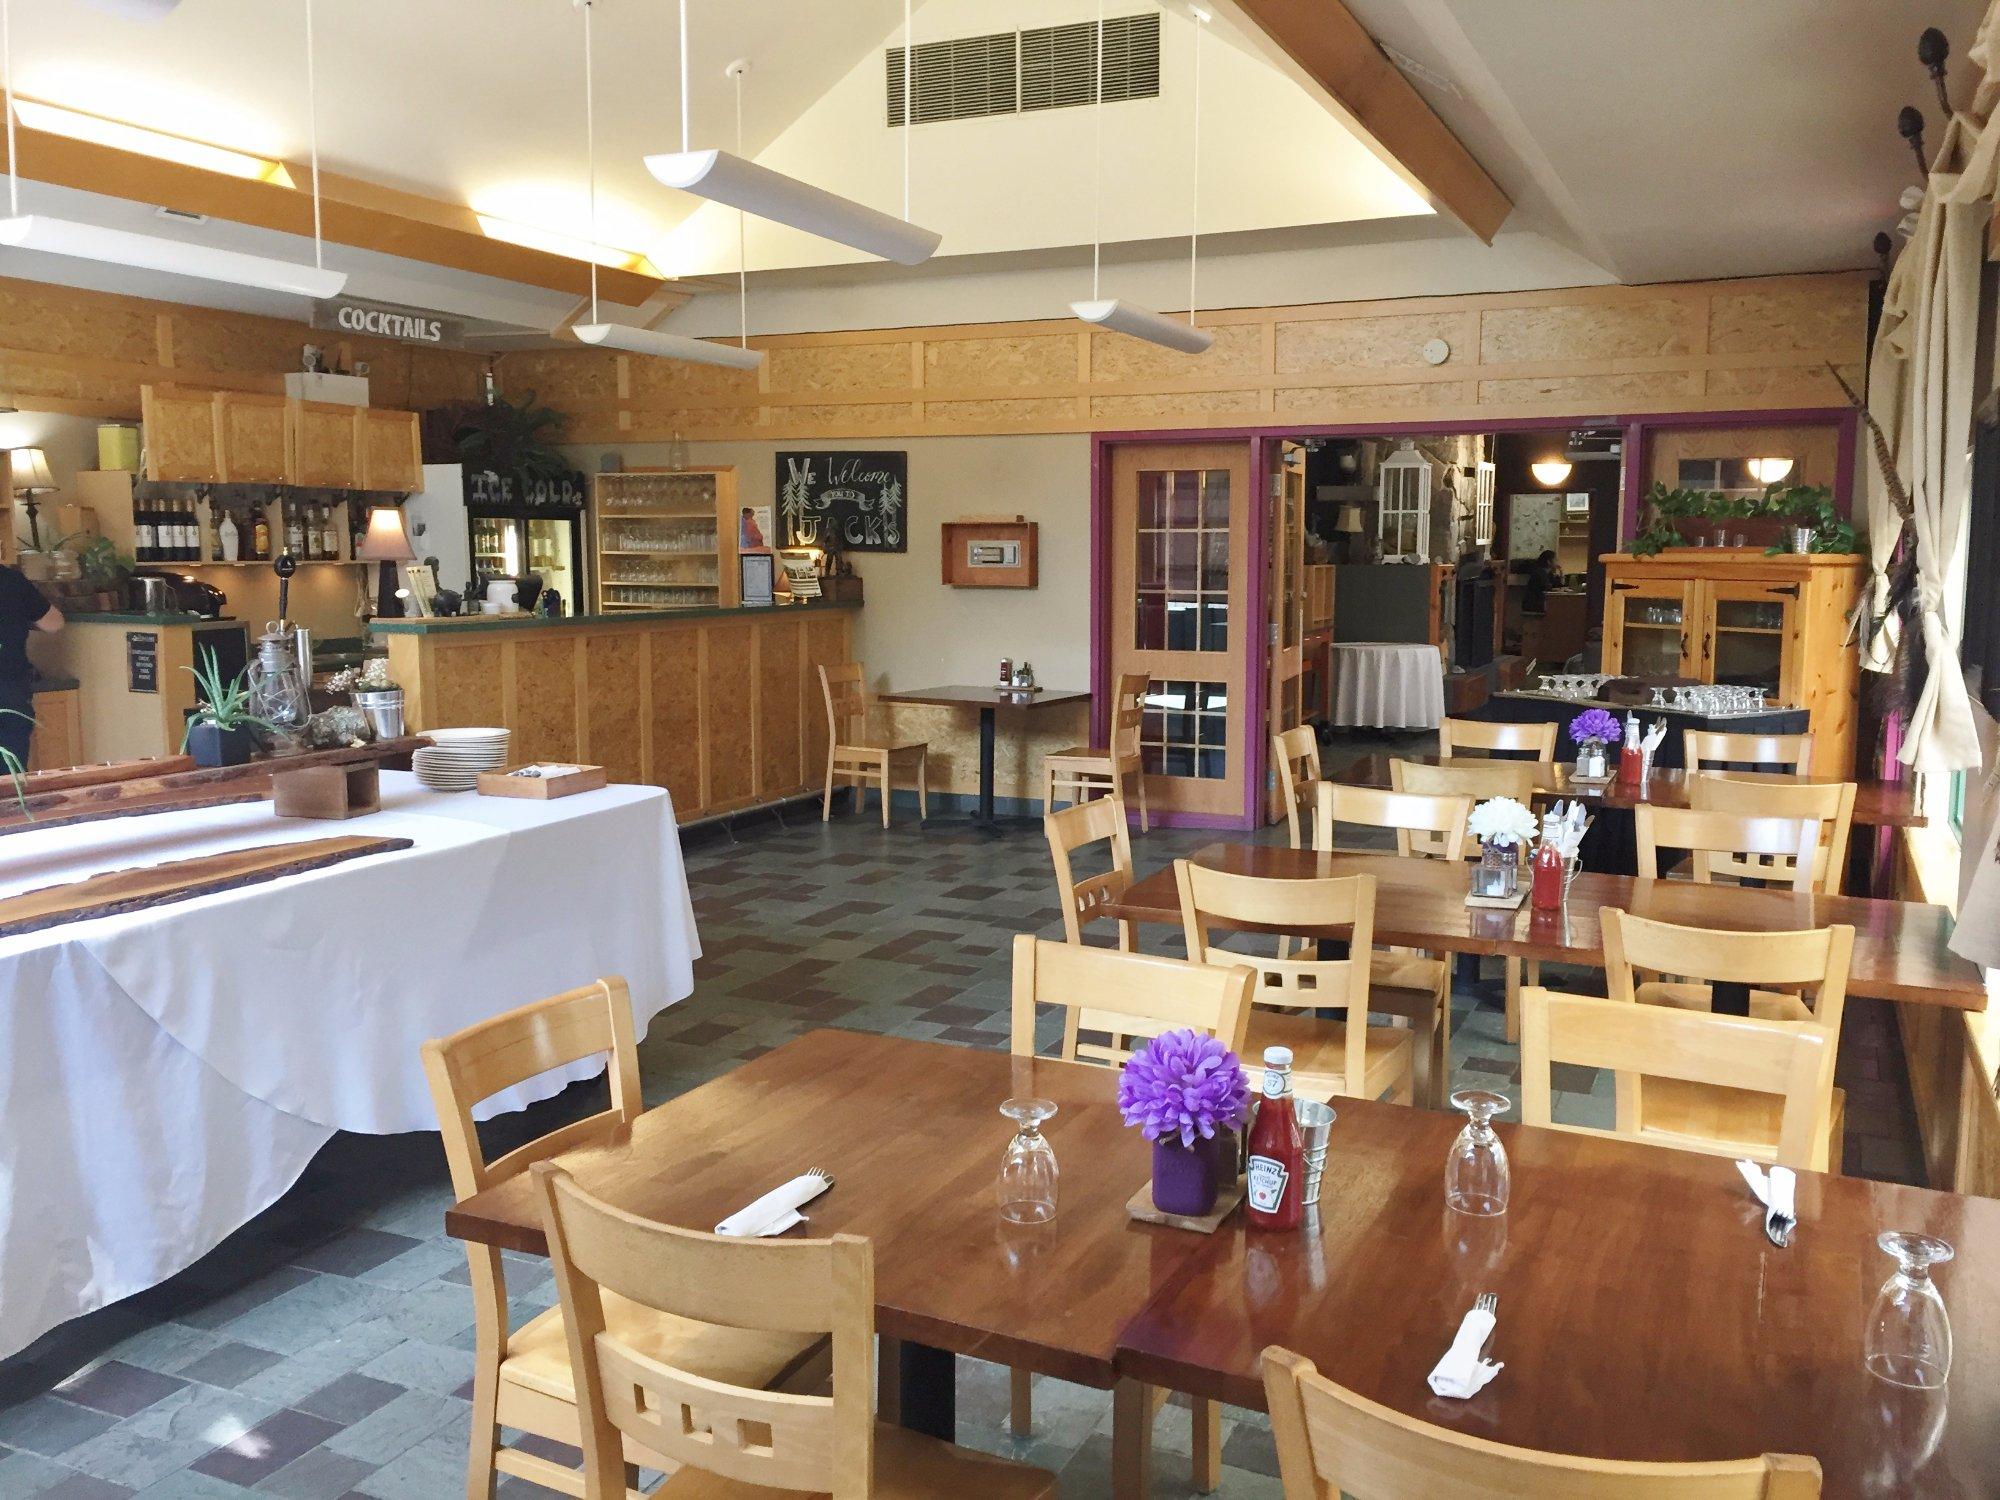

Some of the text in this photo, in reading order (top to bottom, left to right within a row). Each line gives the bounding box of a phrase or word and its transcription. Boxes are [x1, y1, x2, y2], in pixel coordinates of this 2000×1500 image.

[338, 306, 442, 342] COCKTAILS
[470, 470, 513, 504] ICE
[828, 456, 891, 486] Welcome
[1255, 1163, 1277, 1176] HEINZ
